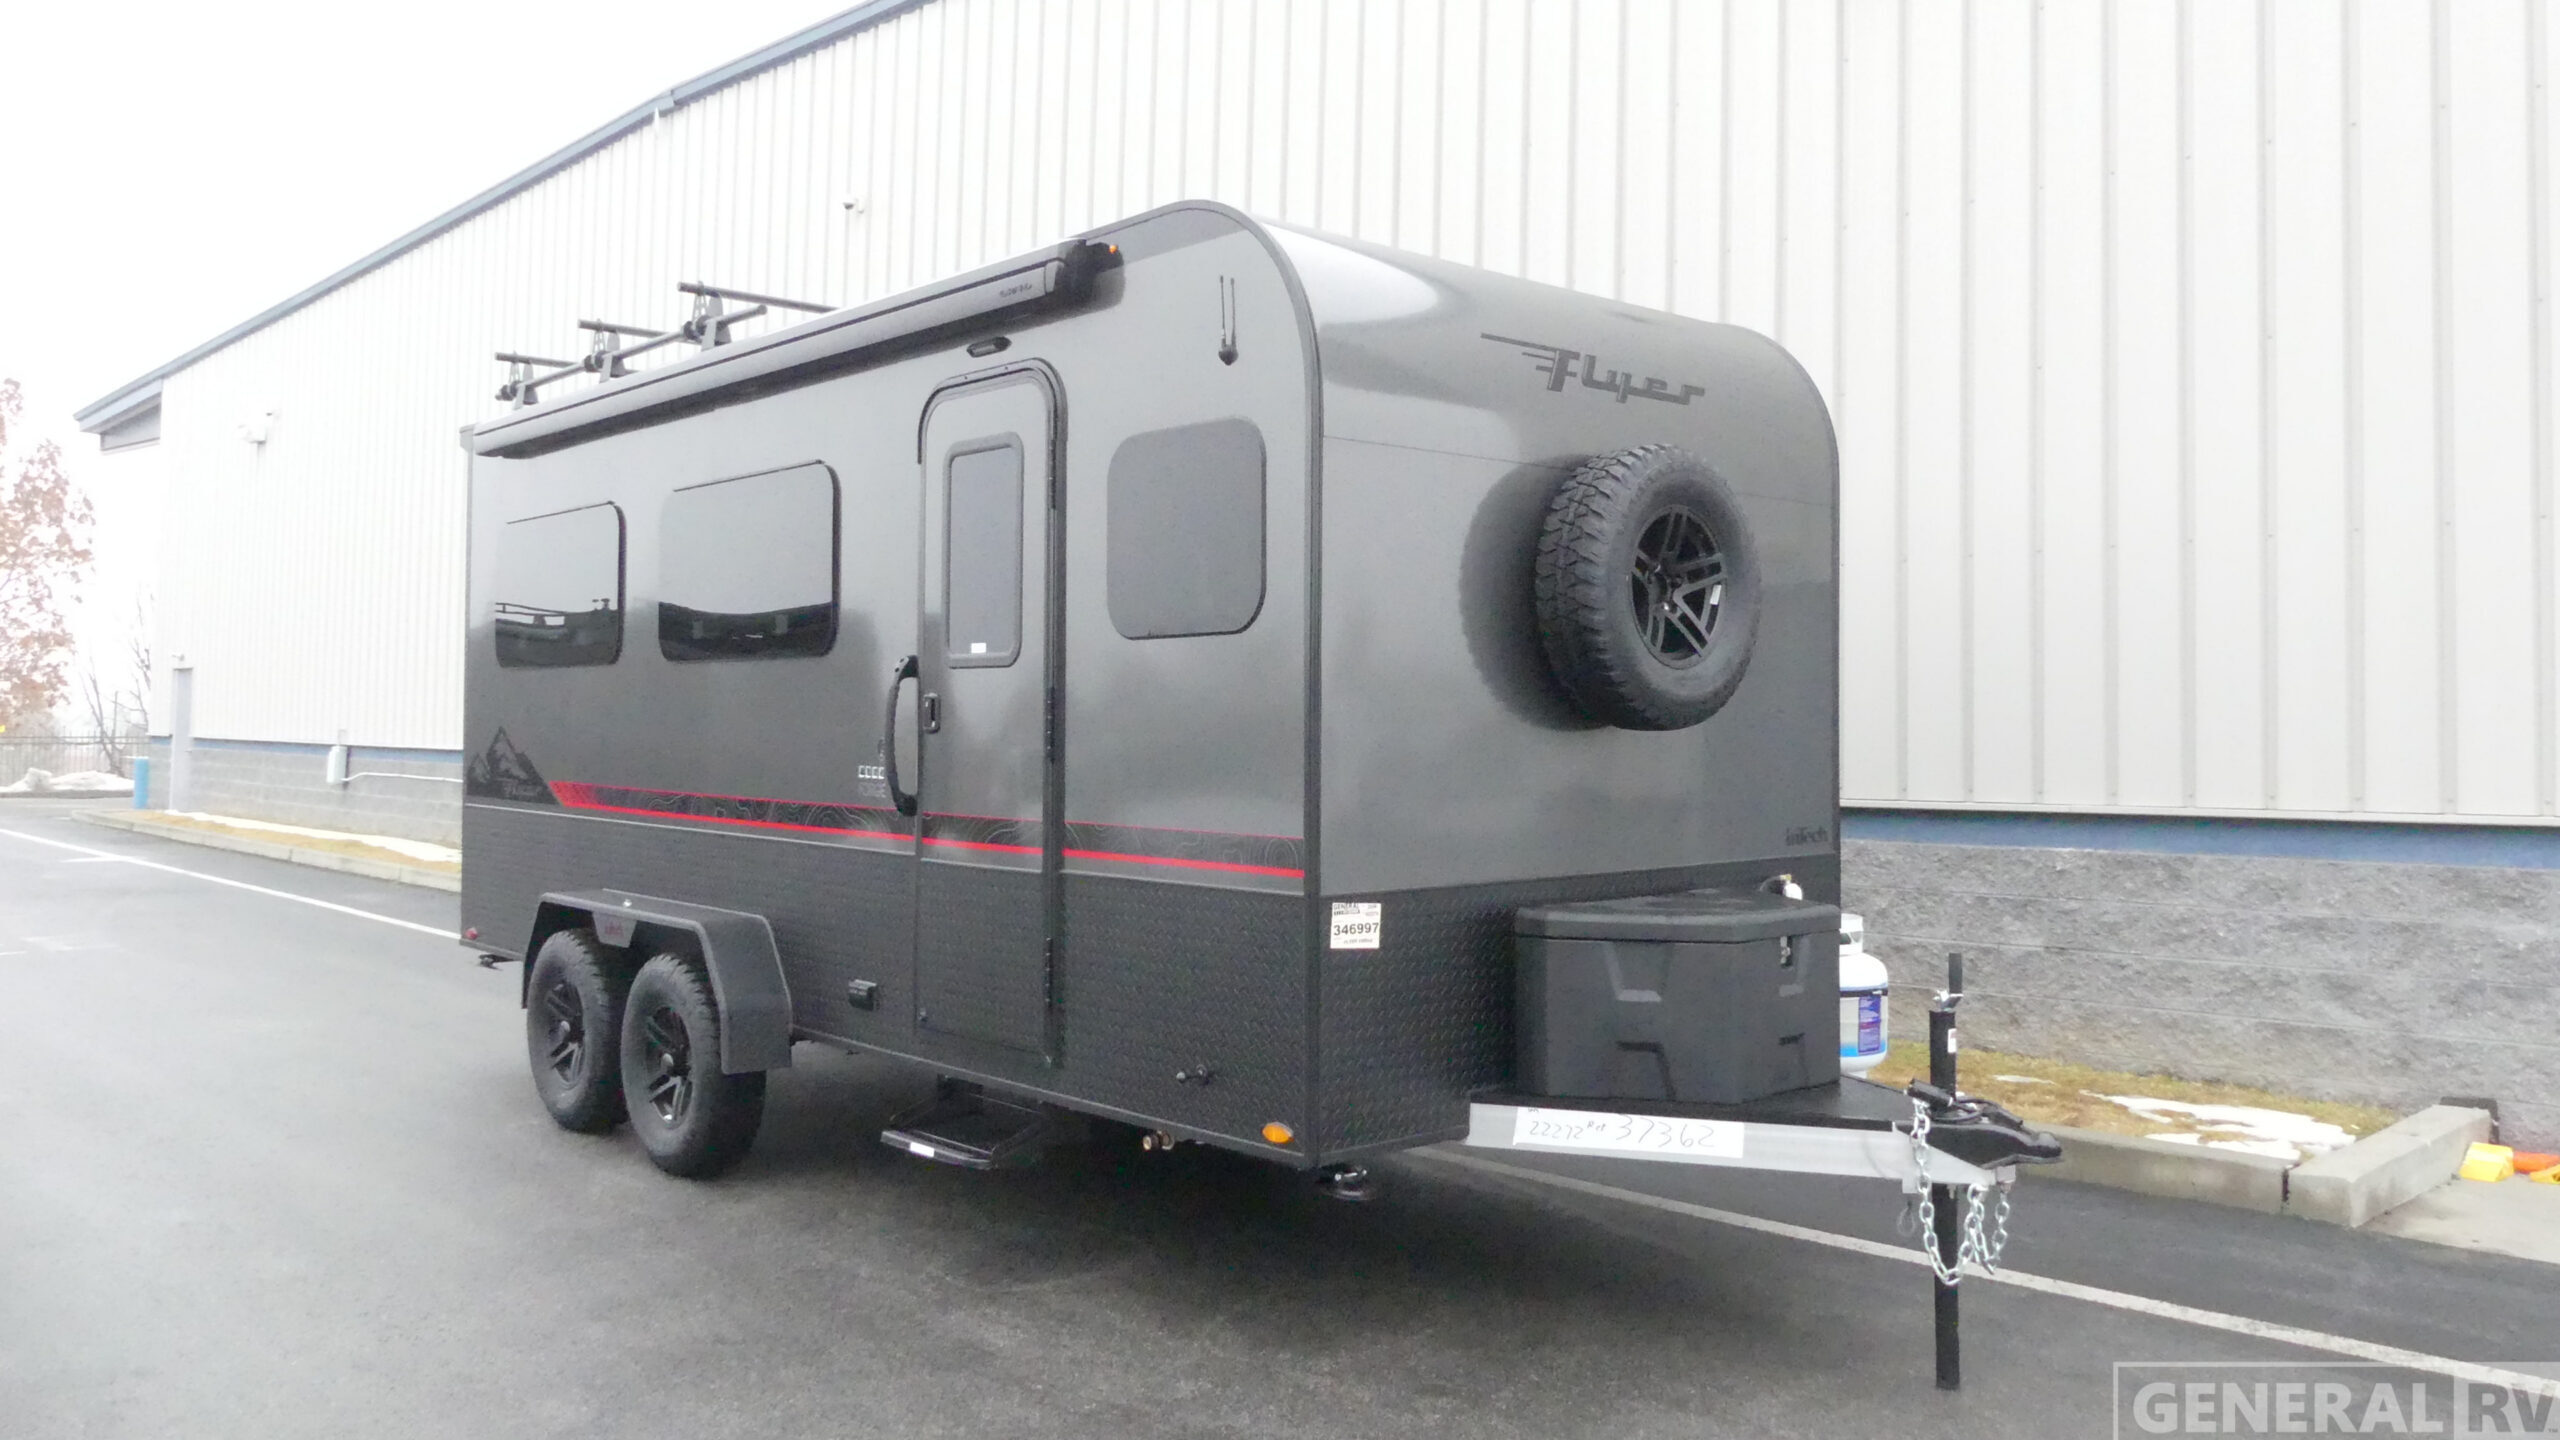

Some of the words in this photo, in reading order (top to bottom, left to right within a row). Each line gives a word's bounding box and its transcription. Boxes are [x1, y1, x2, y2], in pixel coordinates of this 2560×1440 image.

[1480, 332, 1706, 405] Flyer
[1333, 922, 1379, 936] 346997
[1615, 1113, 1715, 1148] 37362
